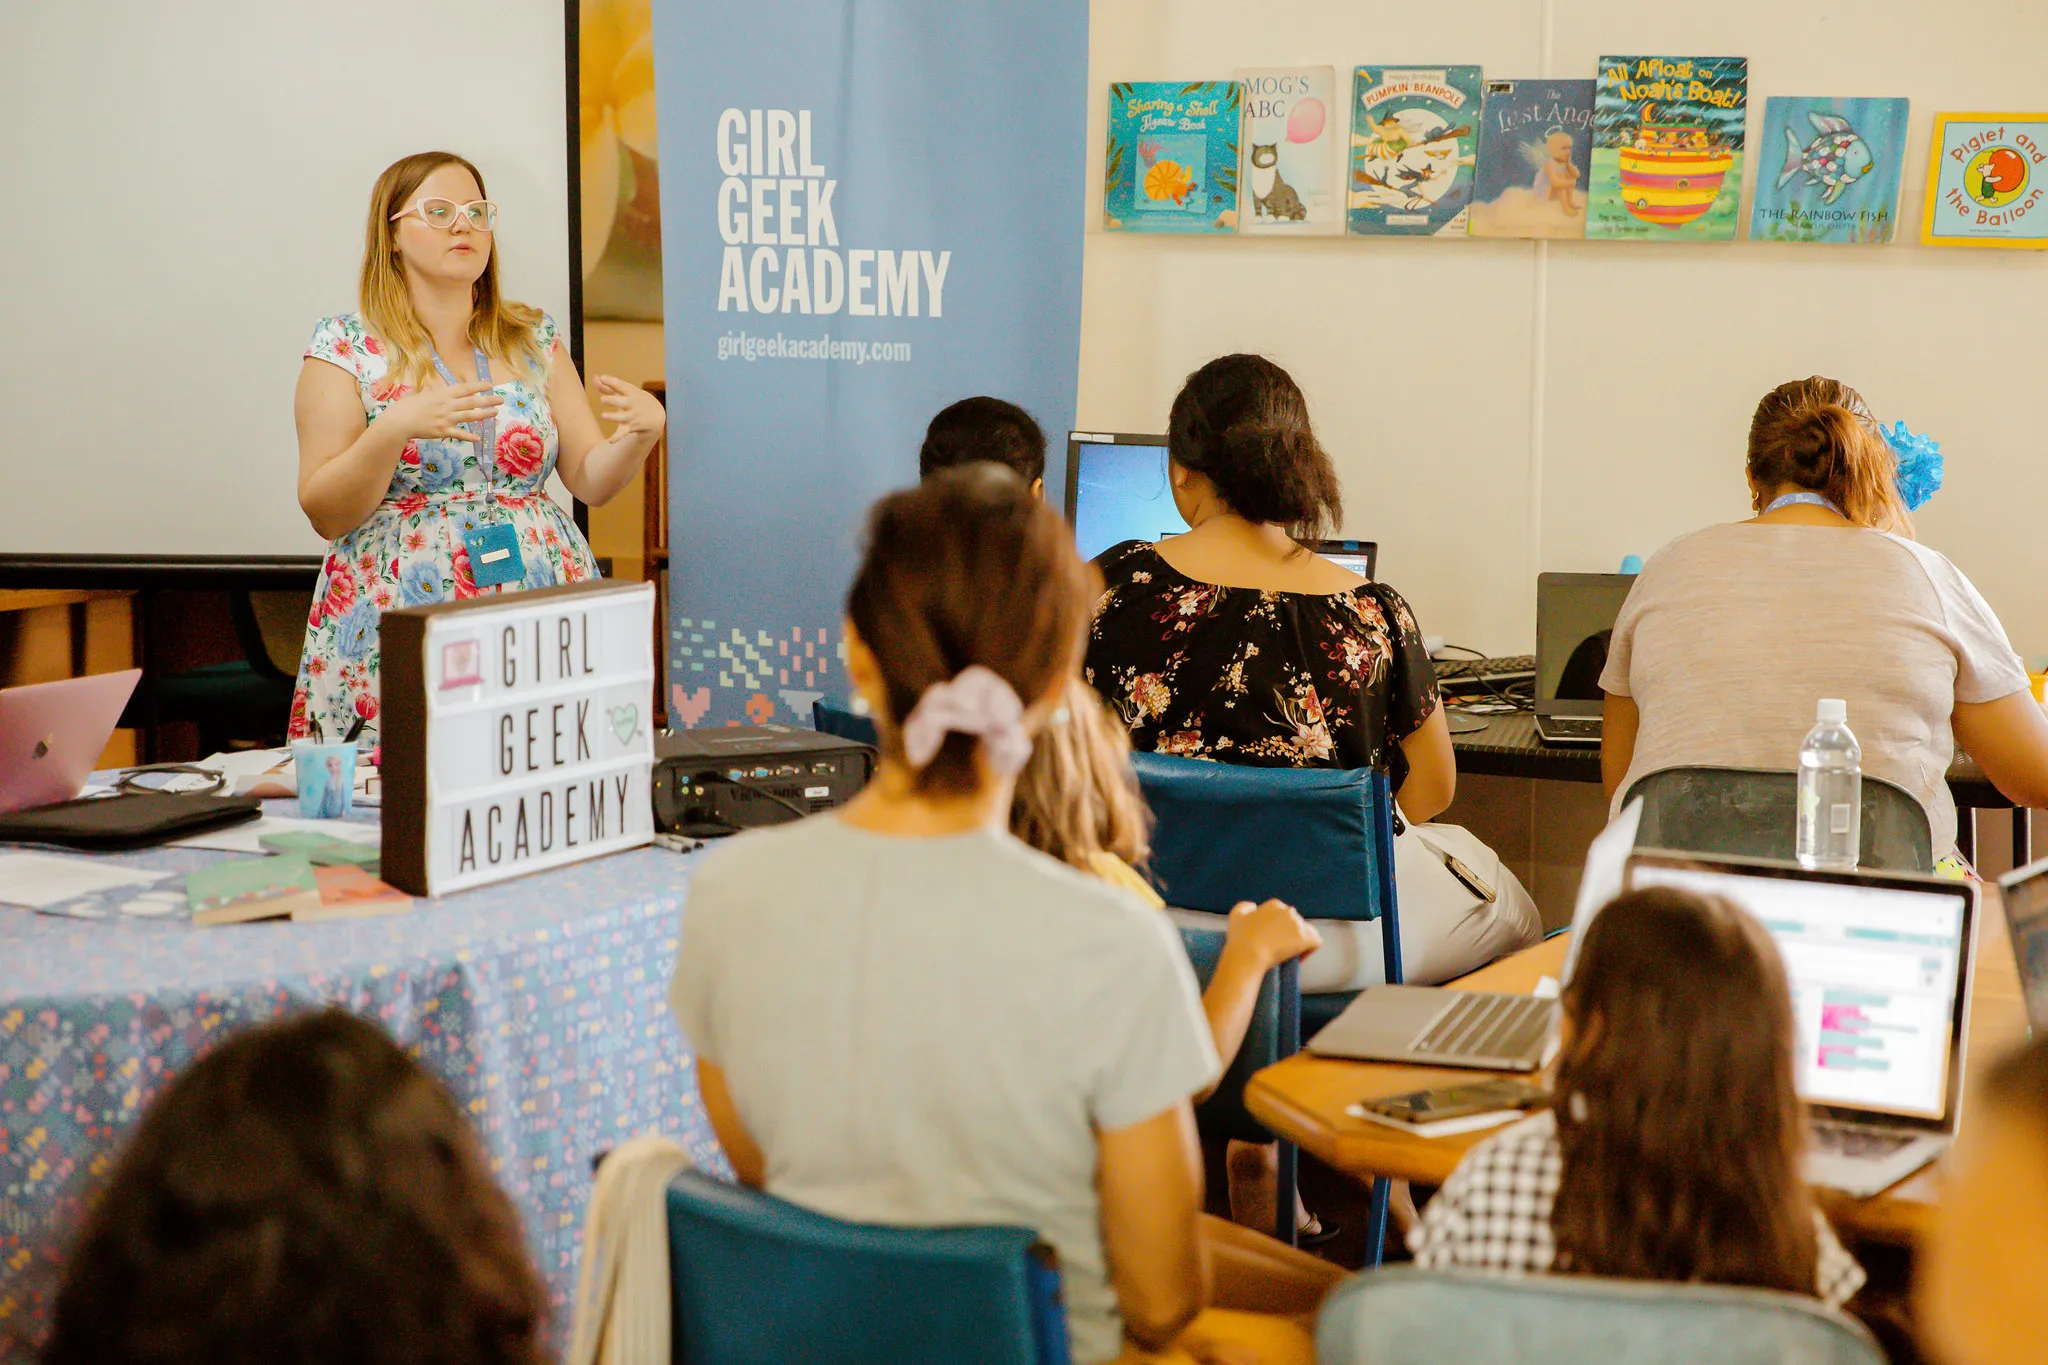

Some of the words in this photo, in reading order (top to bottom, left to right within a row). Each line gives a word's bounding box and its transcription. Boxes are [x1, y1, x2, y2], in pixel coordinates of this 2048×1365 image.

[1245, 76, 1309, 94] MOG'S
[1607, 63, 1628, 88] All
[1635, 59, 1694, 79] Afloat
[1698, 69, 1713, 79] on
[1127, 98, 1175, 119] Sharing
[1185, 99, 1219, 117] Shell
[1244, 100, 1286, 118] ABC
[1366, 83, 1409, 105] PUMPKIN
[1413, 83, 1462, 105] BEANPOLE
[1620, 79, 1684, 102] Noah's
[1687, 80, 1742, 108] Boat!
[1178, 117, 1207, 131] Book
[717, 107, 825, 177] GIRL
[1950, 126, 2004, 163] Piglet
[2015, 134, 2047, 164] and
[717, 177, 840, 247] GEEK
[1761, 208, 1786, 220] THE
[1791, 209, 1856, 221] RAINBOW
[1861, 211, 1888, 222] FISH
[1946, 187, 1970, 217] the
[1975, 189, 2044, 227] Balloon
[717, 246, 952, 317] ACADEMY
[717, 330, 911, 365] girlgeekacademy.com
[502, 613, 594, 687] GIRL
[500, 699, 590, 775] GEEK
[460, 774, 628, 873] ACADEMY
